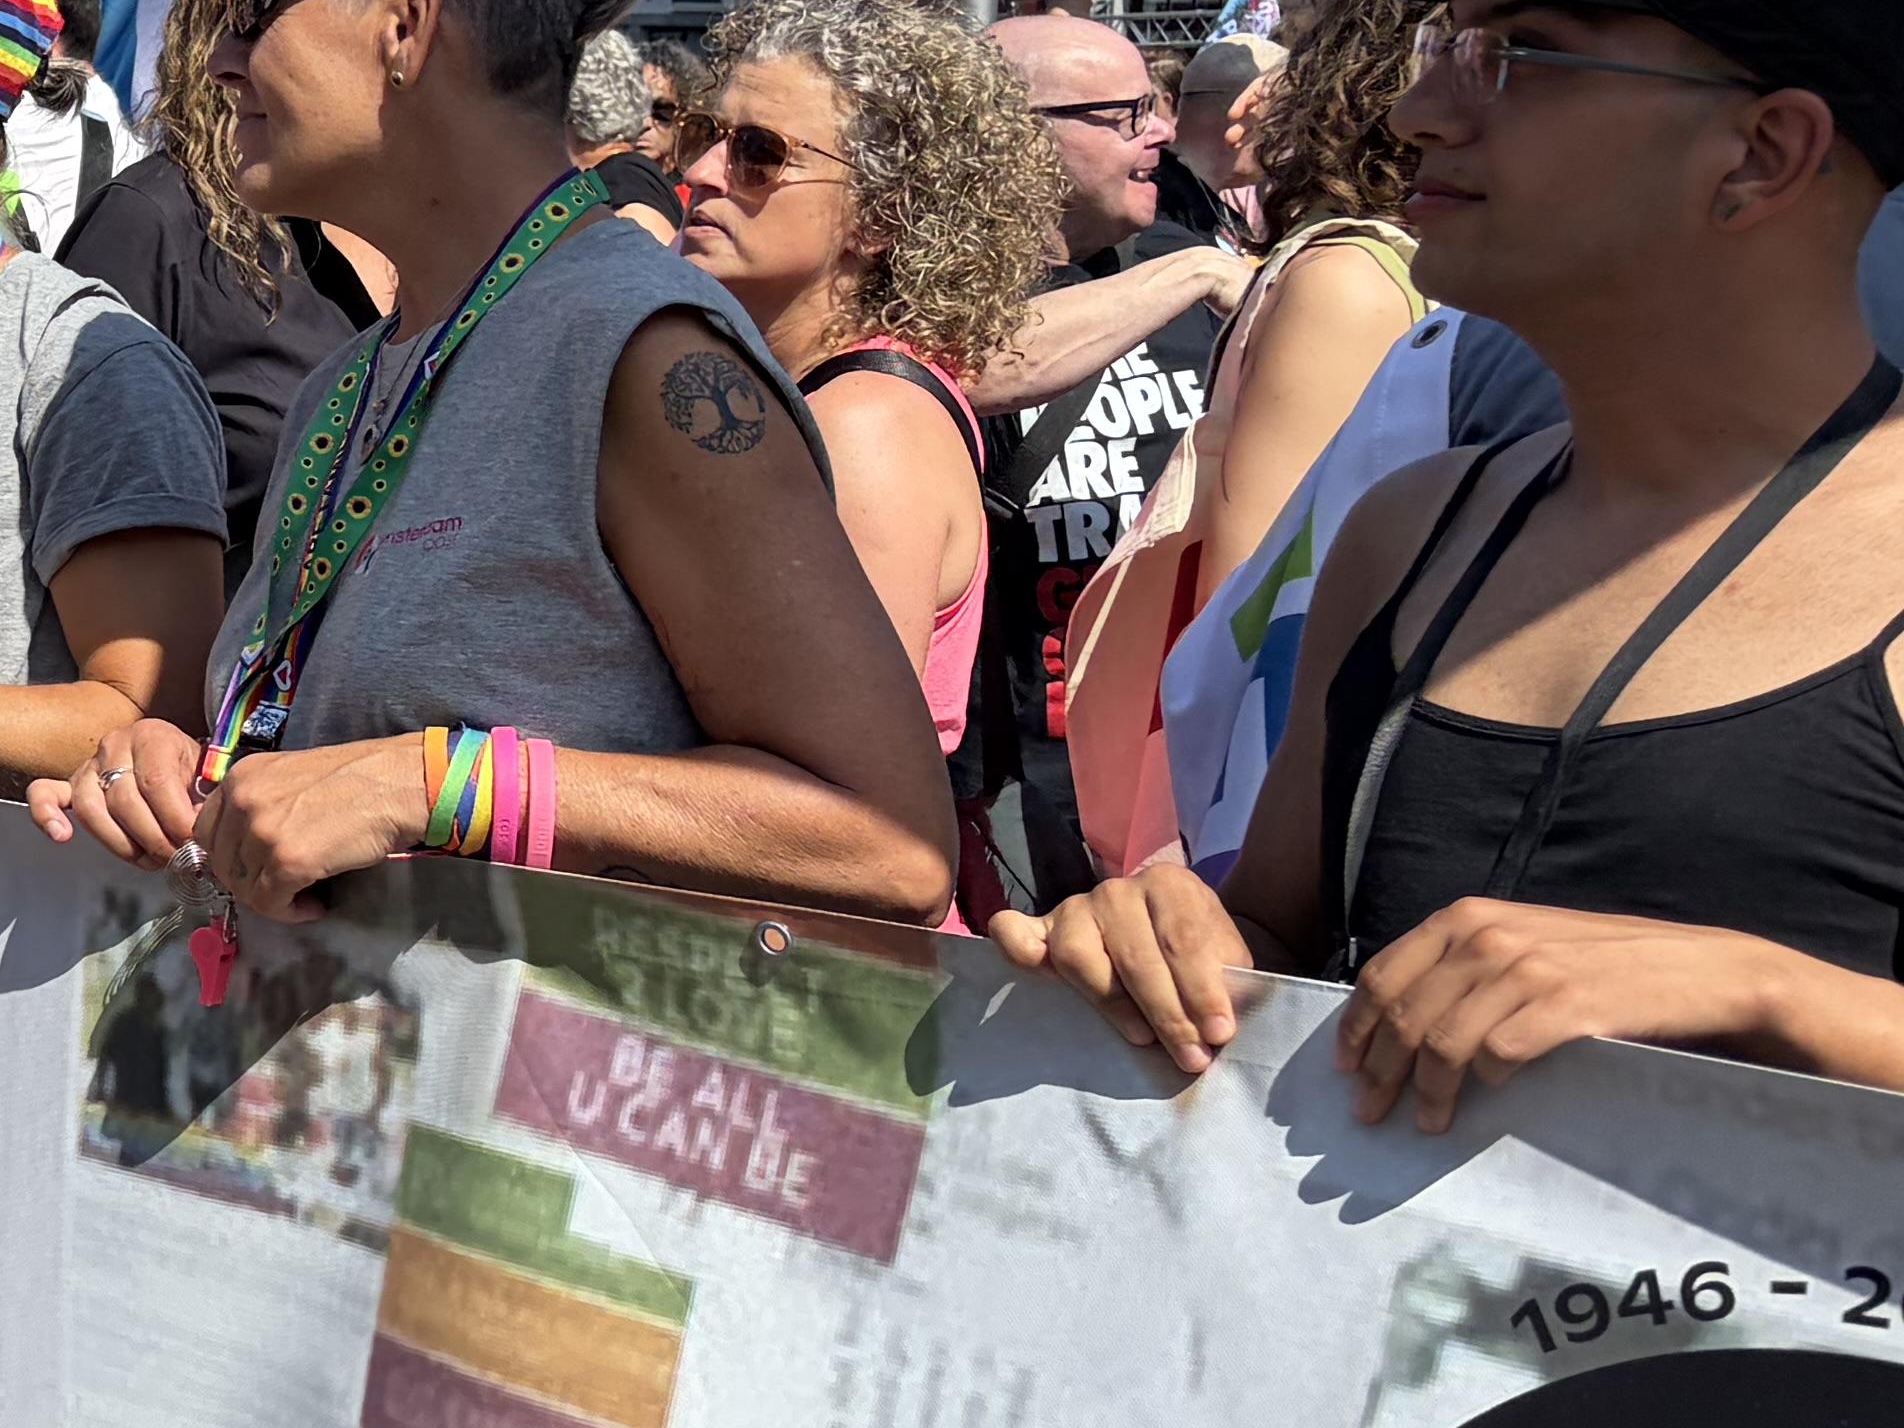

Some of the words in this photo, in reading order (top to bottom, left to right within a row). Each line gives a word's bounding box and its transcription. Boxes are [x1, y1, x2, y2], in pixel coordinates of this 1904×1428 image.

[1020, 370, 1208, 442] OPLE
[1027, 437, 1146, 508] ARE
[1024, 493, 1143, 563] TRA
[607, 1033, 677, 1096] BE
[692, 1062, 790, 1138] ALL
[567, 1070, 608, 1126] U
[617, 1094, 730, 1172] CAN
[740, 1127, 820, 1207] BE
[1509, 1260, 1736, 1354] 1946
[1841, 1264, 1904, 1330] 2
